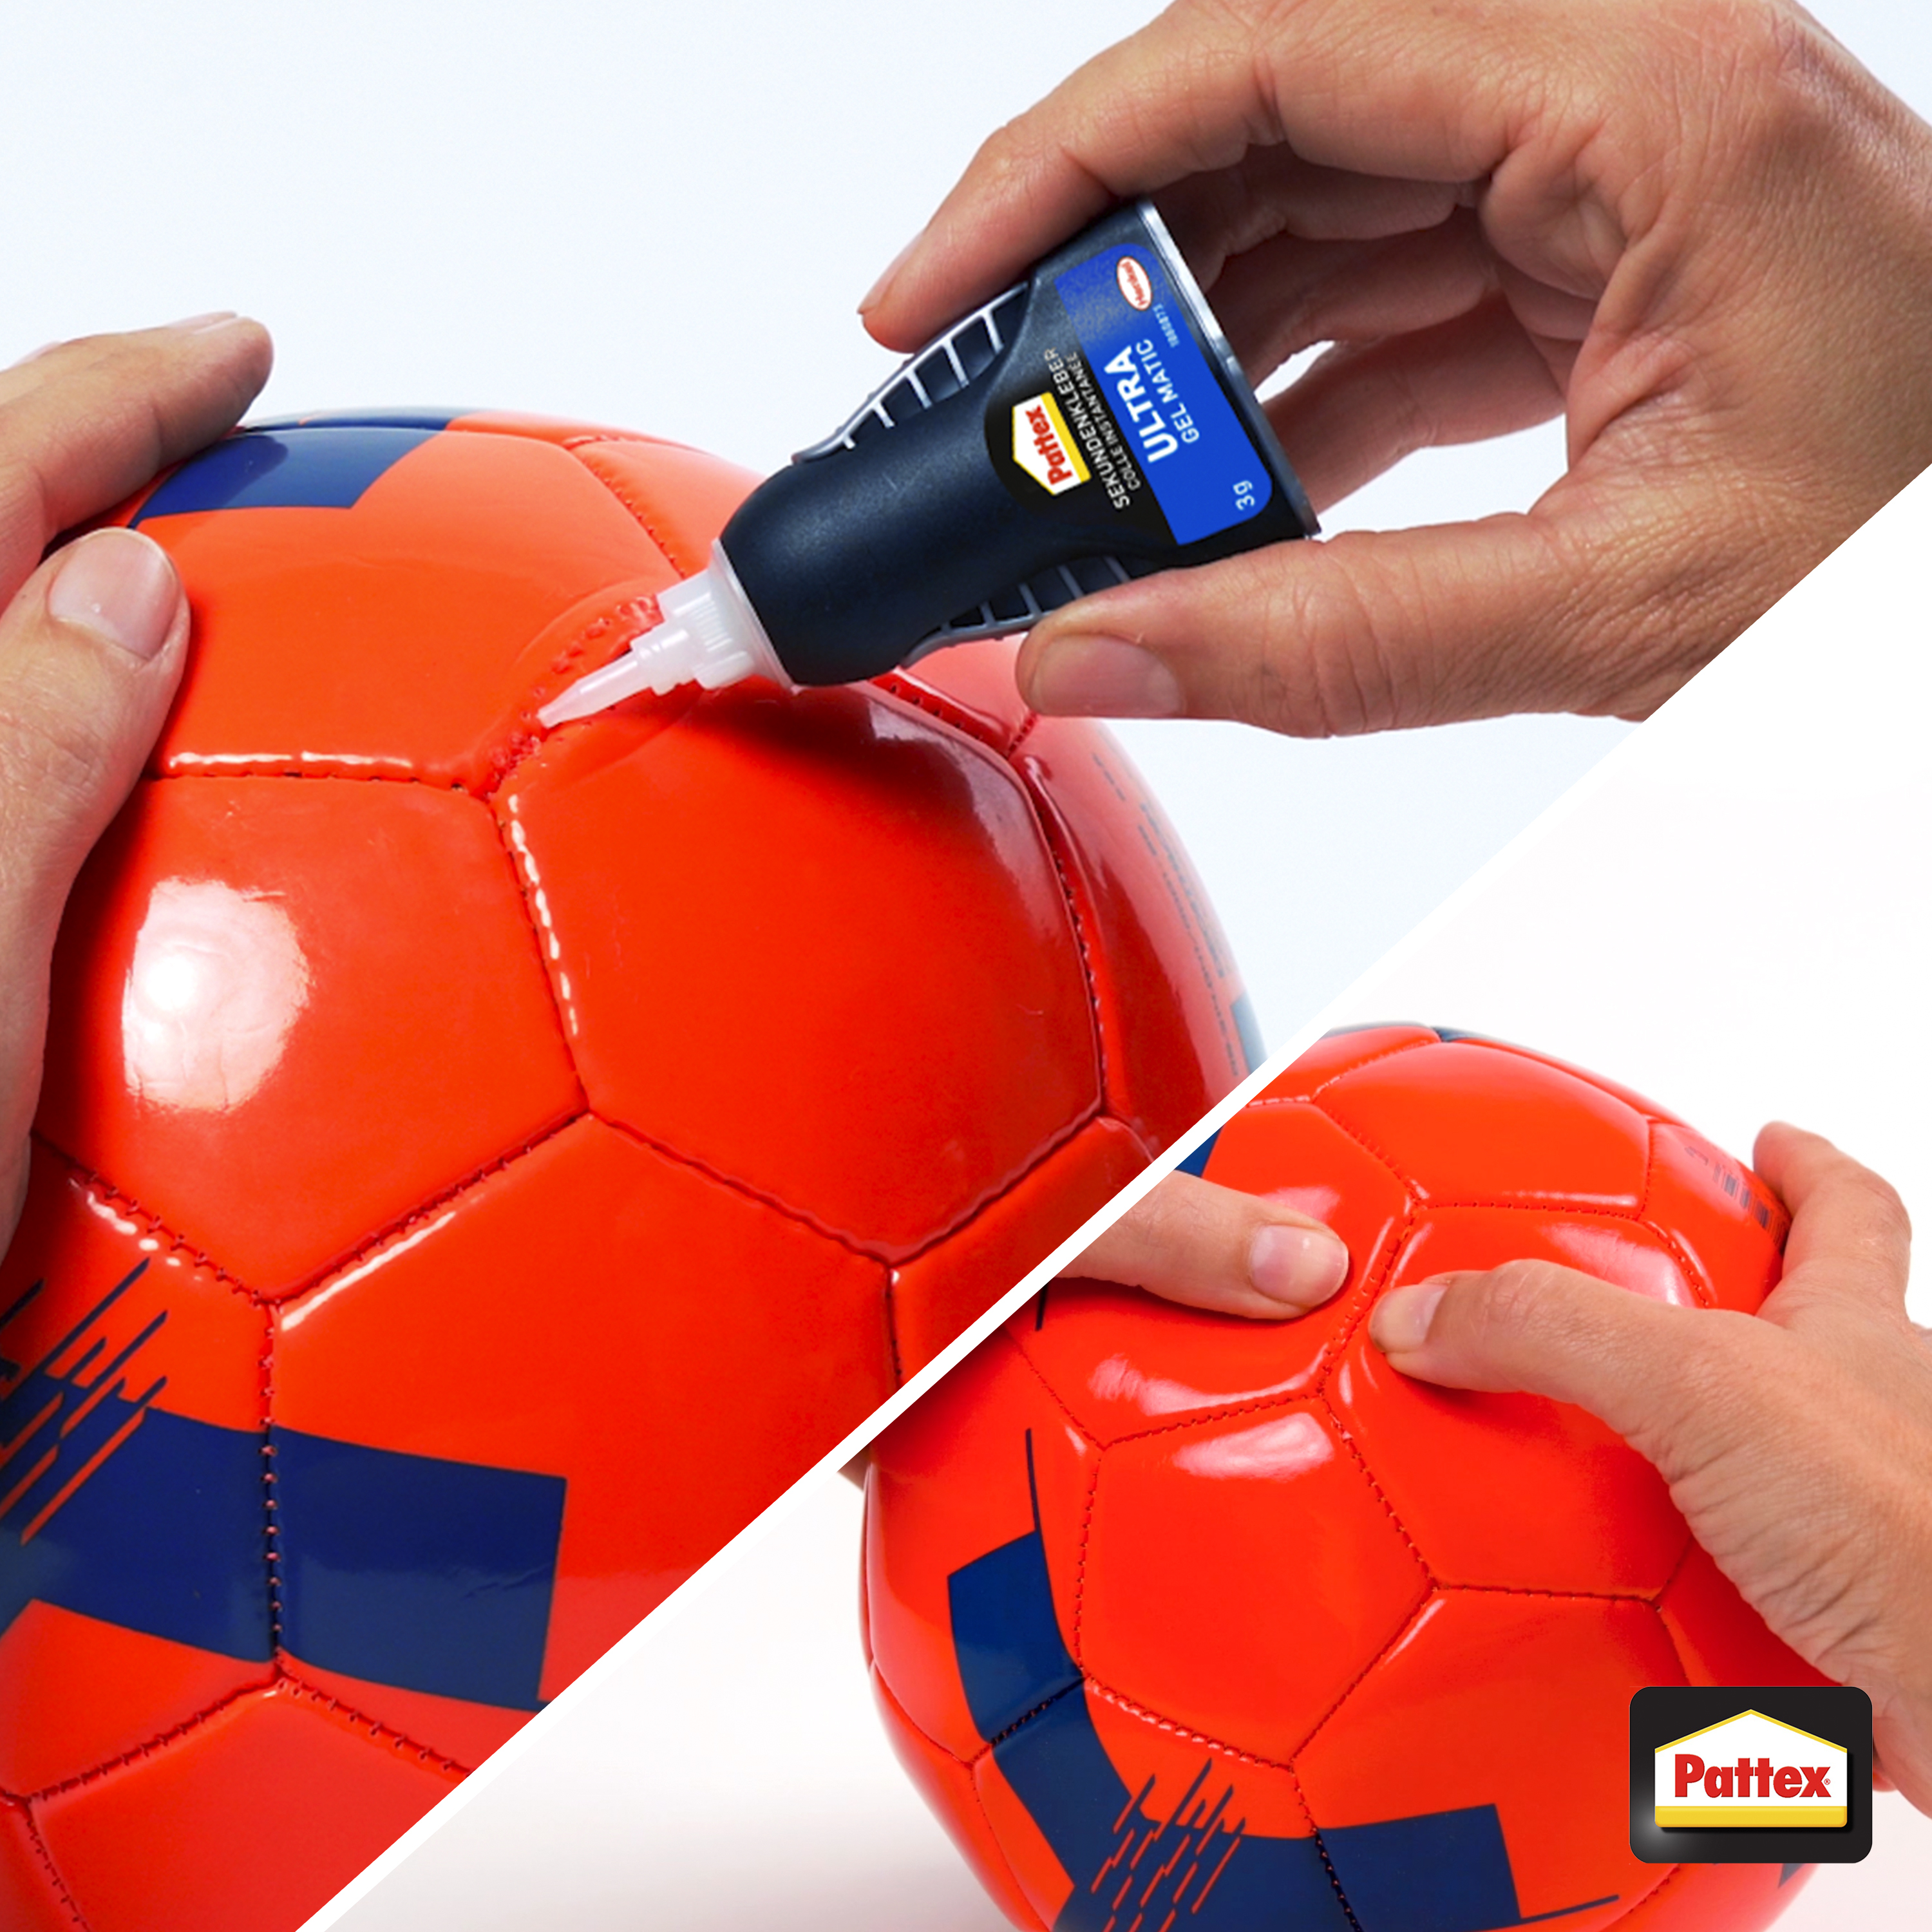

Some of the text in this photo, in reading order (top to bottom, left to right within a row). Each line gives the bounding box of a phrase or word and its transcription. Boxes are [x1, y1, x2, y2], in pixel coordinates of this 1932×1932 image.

[1044, 347, 1130, 509] SEKUNDENKLEBER
[1104, 345, 1179, 462] ULTRA
[1135, 339, 1200, 443] GEL MATIC
[1025, 404, 1074, 485] Pattex
[1110, 445, 1141, 491] COLLE
[1233, 480, 1255, 510] 3g
